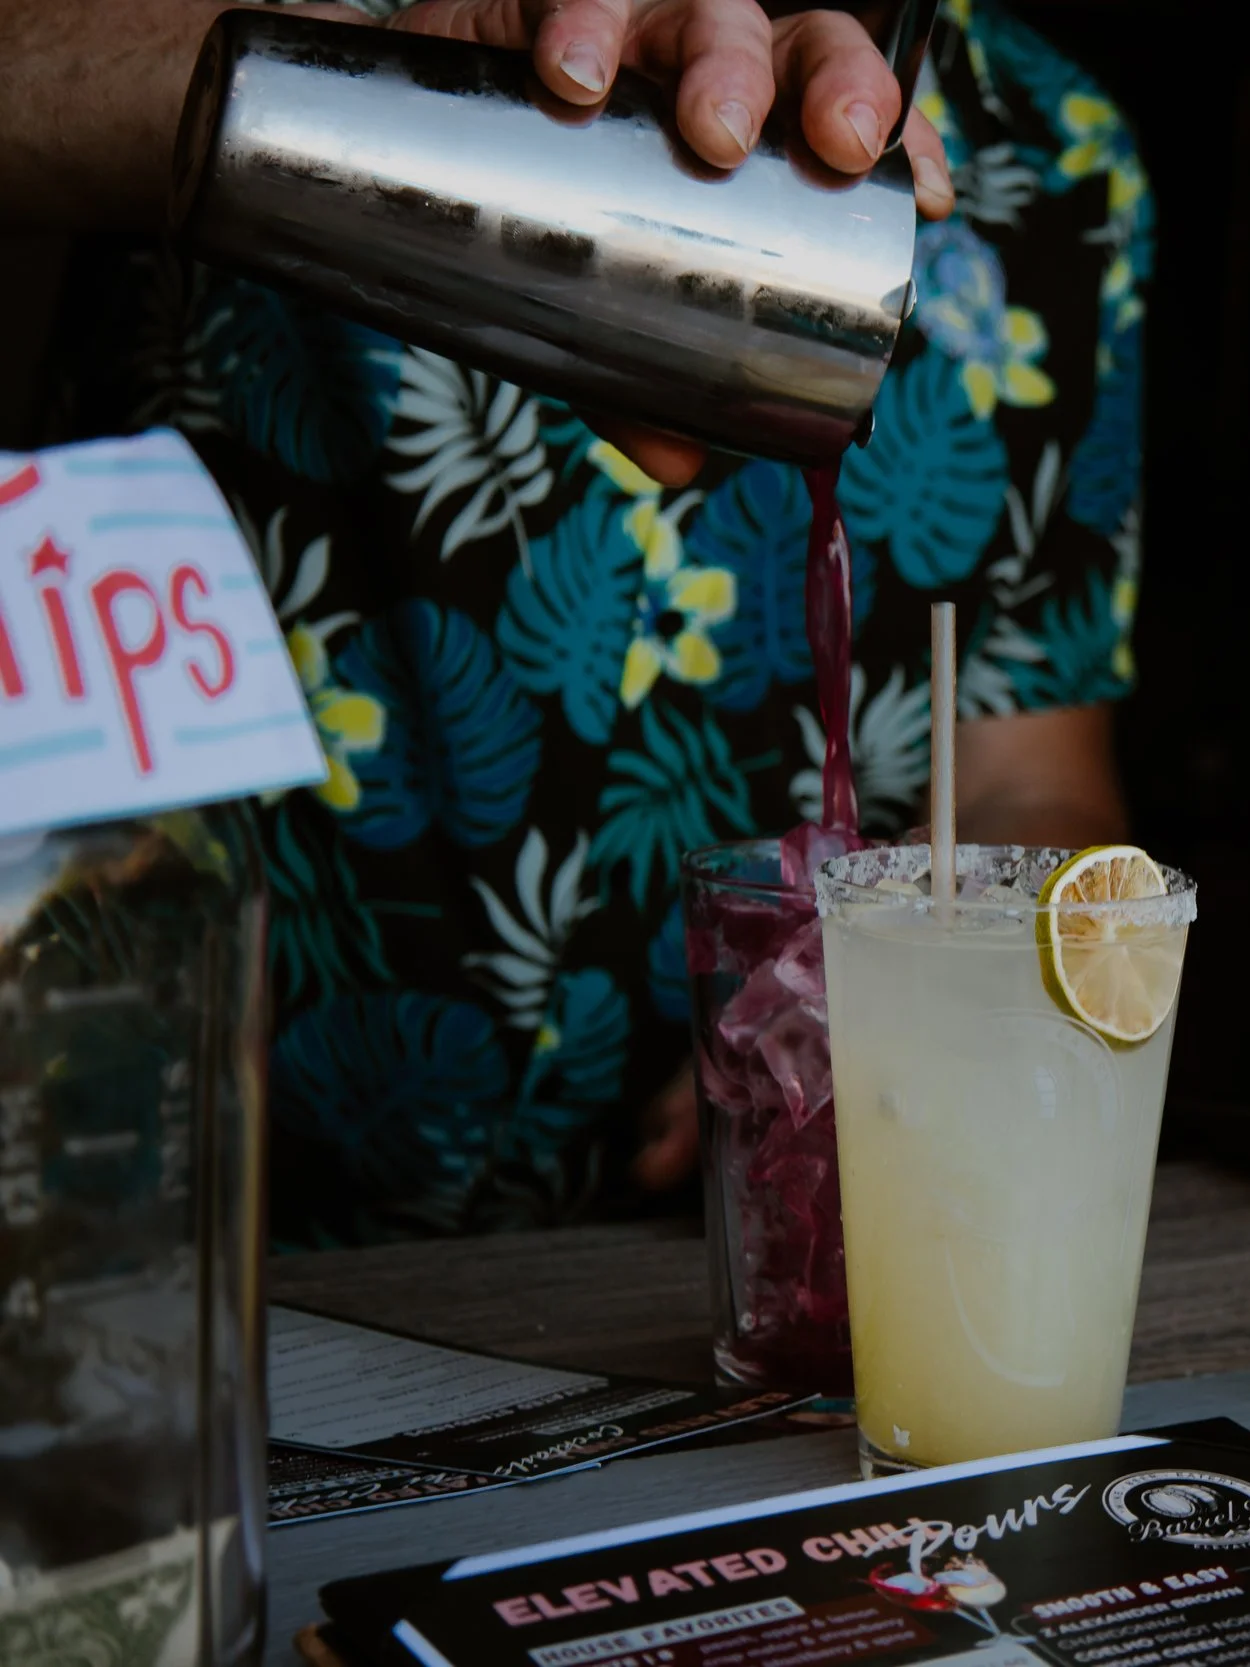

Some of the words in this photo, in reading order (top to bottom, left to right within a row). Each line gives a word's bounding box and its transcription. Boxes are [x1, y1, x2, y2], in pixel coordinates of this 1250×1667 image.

[863, 1483, 1092, 1577] Pours
[1128, 1499, 1240, 1542] Barrel
[493, 1547, 787, 1627] ELEVATED
[1032, 1587, 1136, 1618] SMOOTH
[1140, 1582, 1162, 1594] &
[1162, 1566, 1228, 1590] EASY
[1058, 1604, 1170, 1634] ALEXANDER
[1170, 1586, 1244, 1608] BROWN
[540, 1636, 628, 1663] HOUSE
[642, 1602, 792, 1642] FAVORITES
[1074, 1638, 1154, 1662] COELHO
[1154, 1624, 1210, 1644] PINOT
[1162, 1638, 1224, 1658] CREEK
